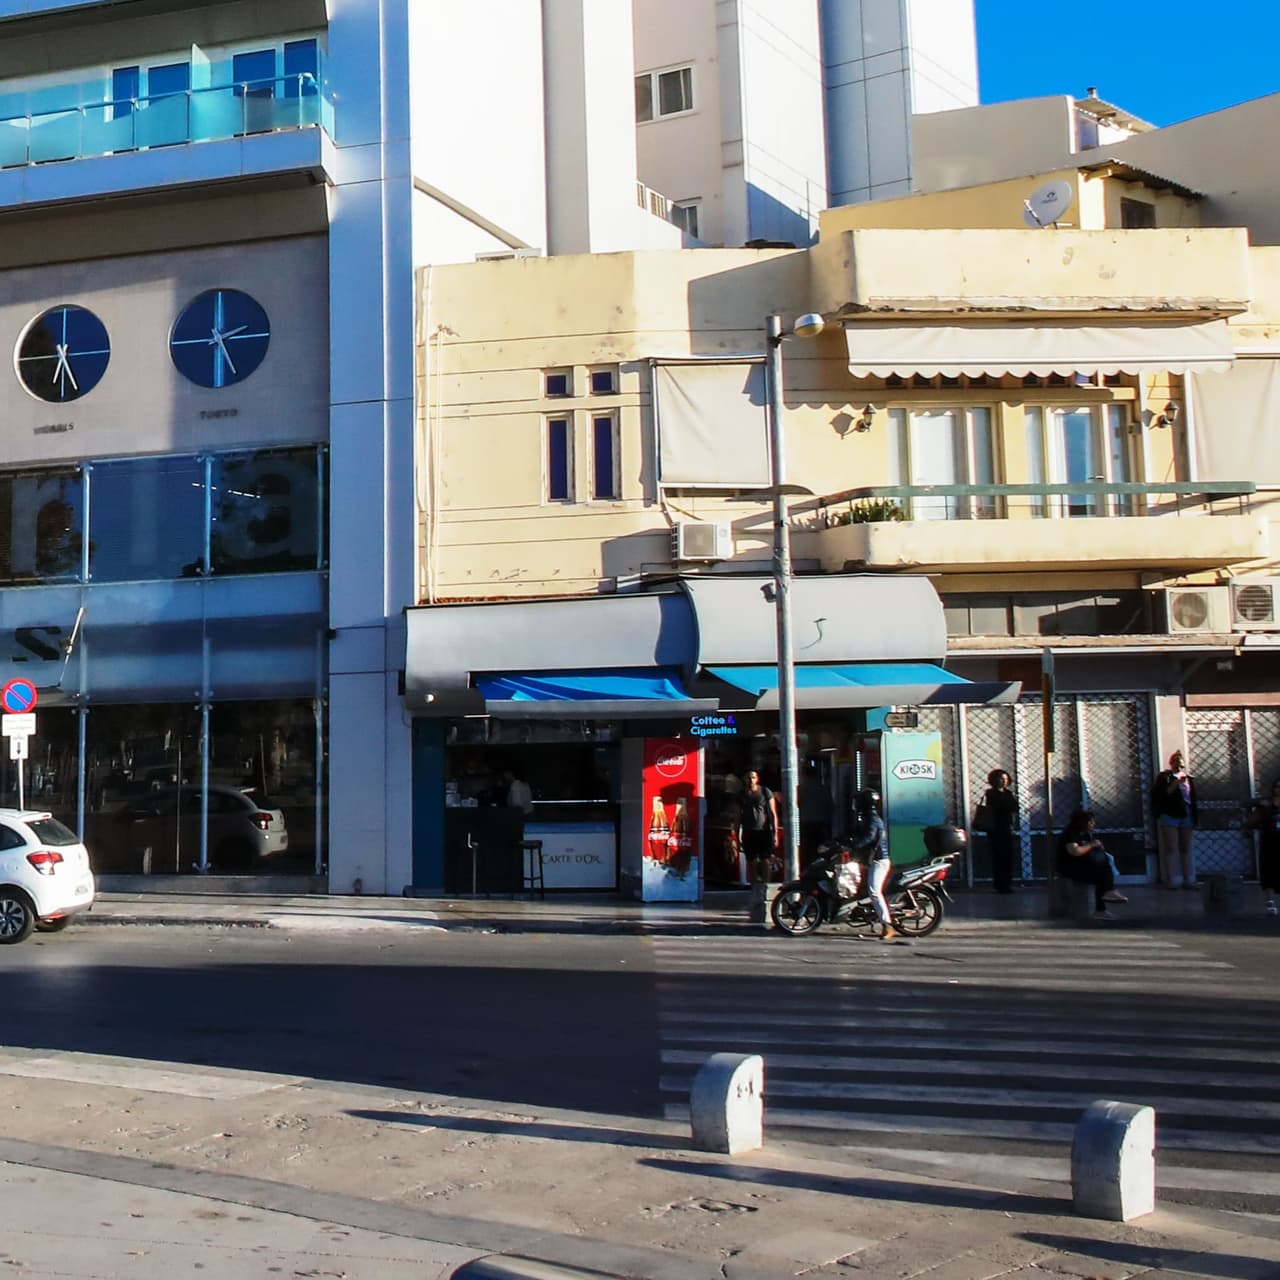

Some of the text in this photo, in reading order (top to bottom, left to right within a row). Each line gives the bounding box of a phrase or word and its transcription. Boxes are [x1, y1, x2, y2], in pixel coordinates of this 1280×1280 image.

[691, 716, 726, 725] Coffee
[690, 726, 738, 737] Cigarettes
[900, 763, 933, 775] KIOSK
